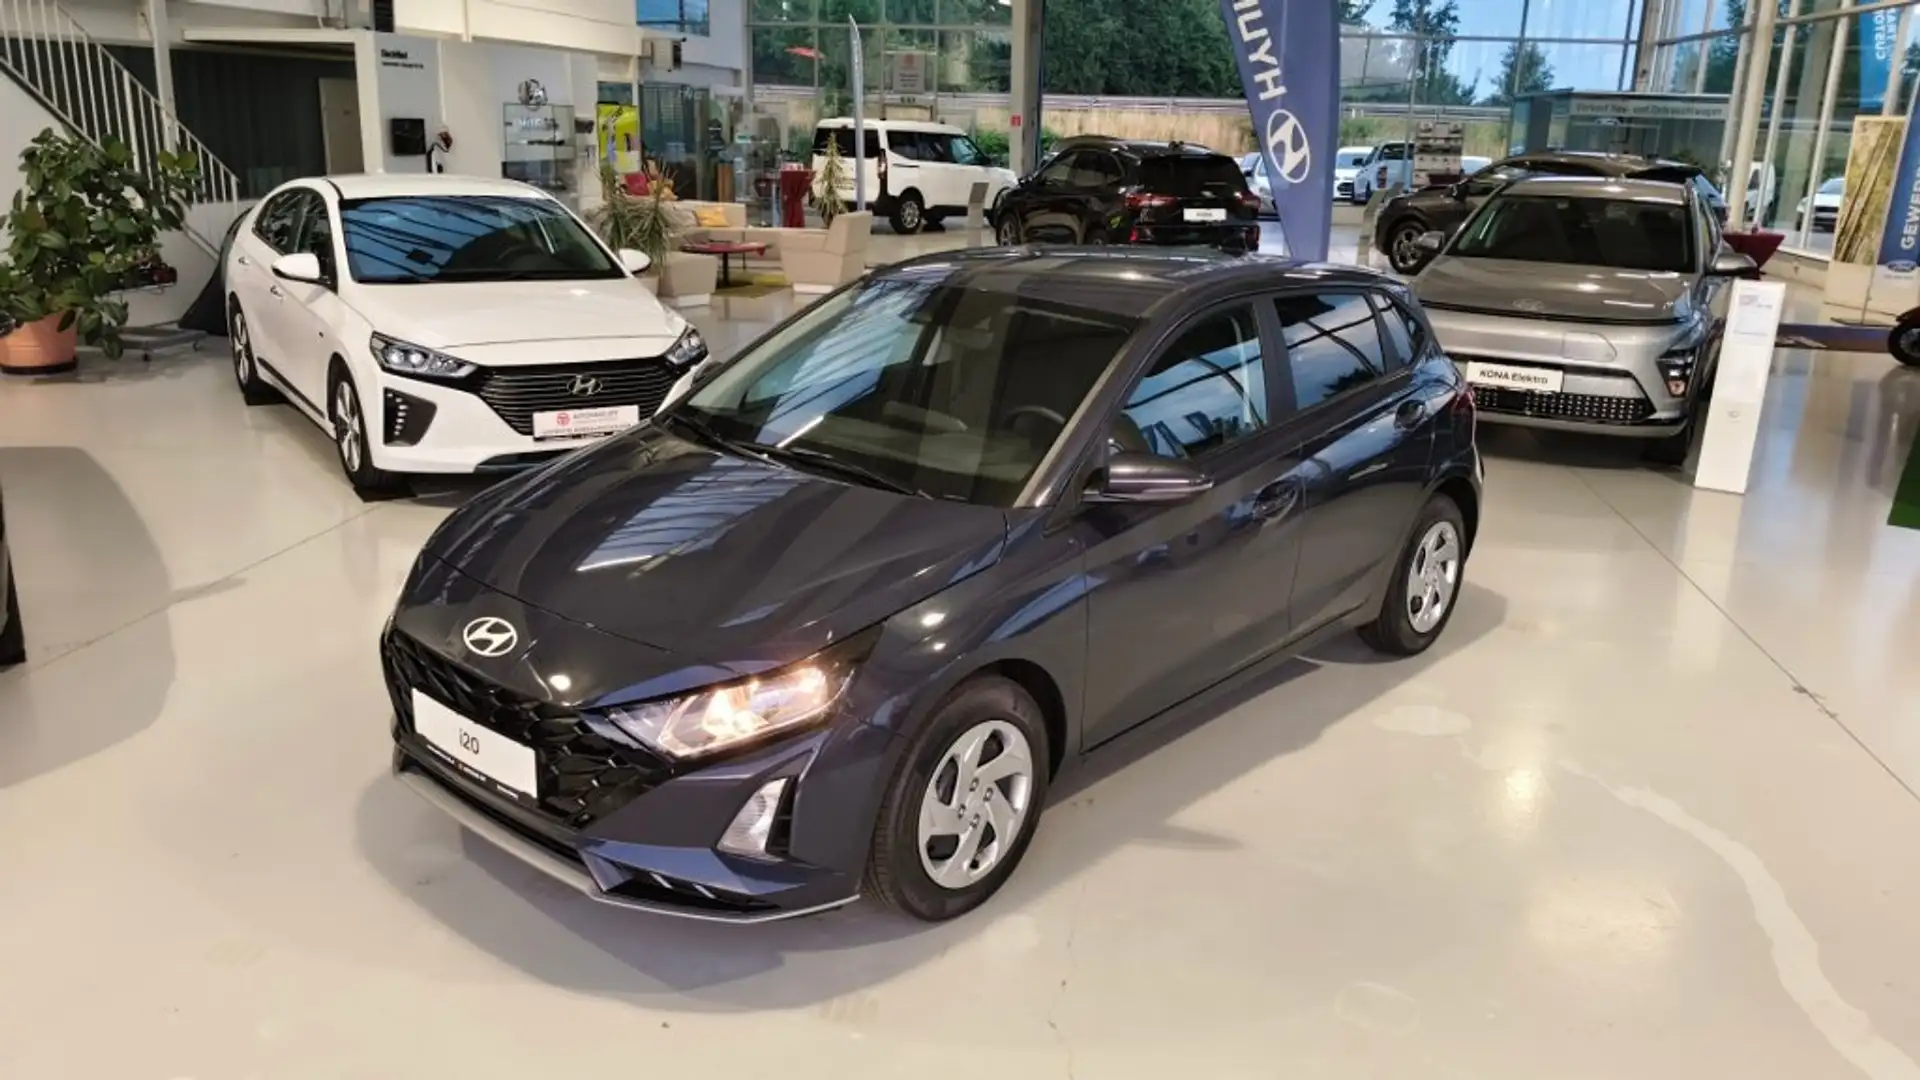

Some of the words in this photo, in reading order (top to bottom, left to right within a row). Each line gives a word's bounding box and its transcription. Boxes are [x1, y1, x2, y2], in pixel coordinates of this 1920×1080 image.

[1479, 369, 1510, 380] KONA
[1511, 372, 1549, 384] Elektro
[459, 727, 480, 755] i20
